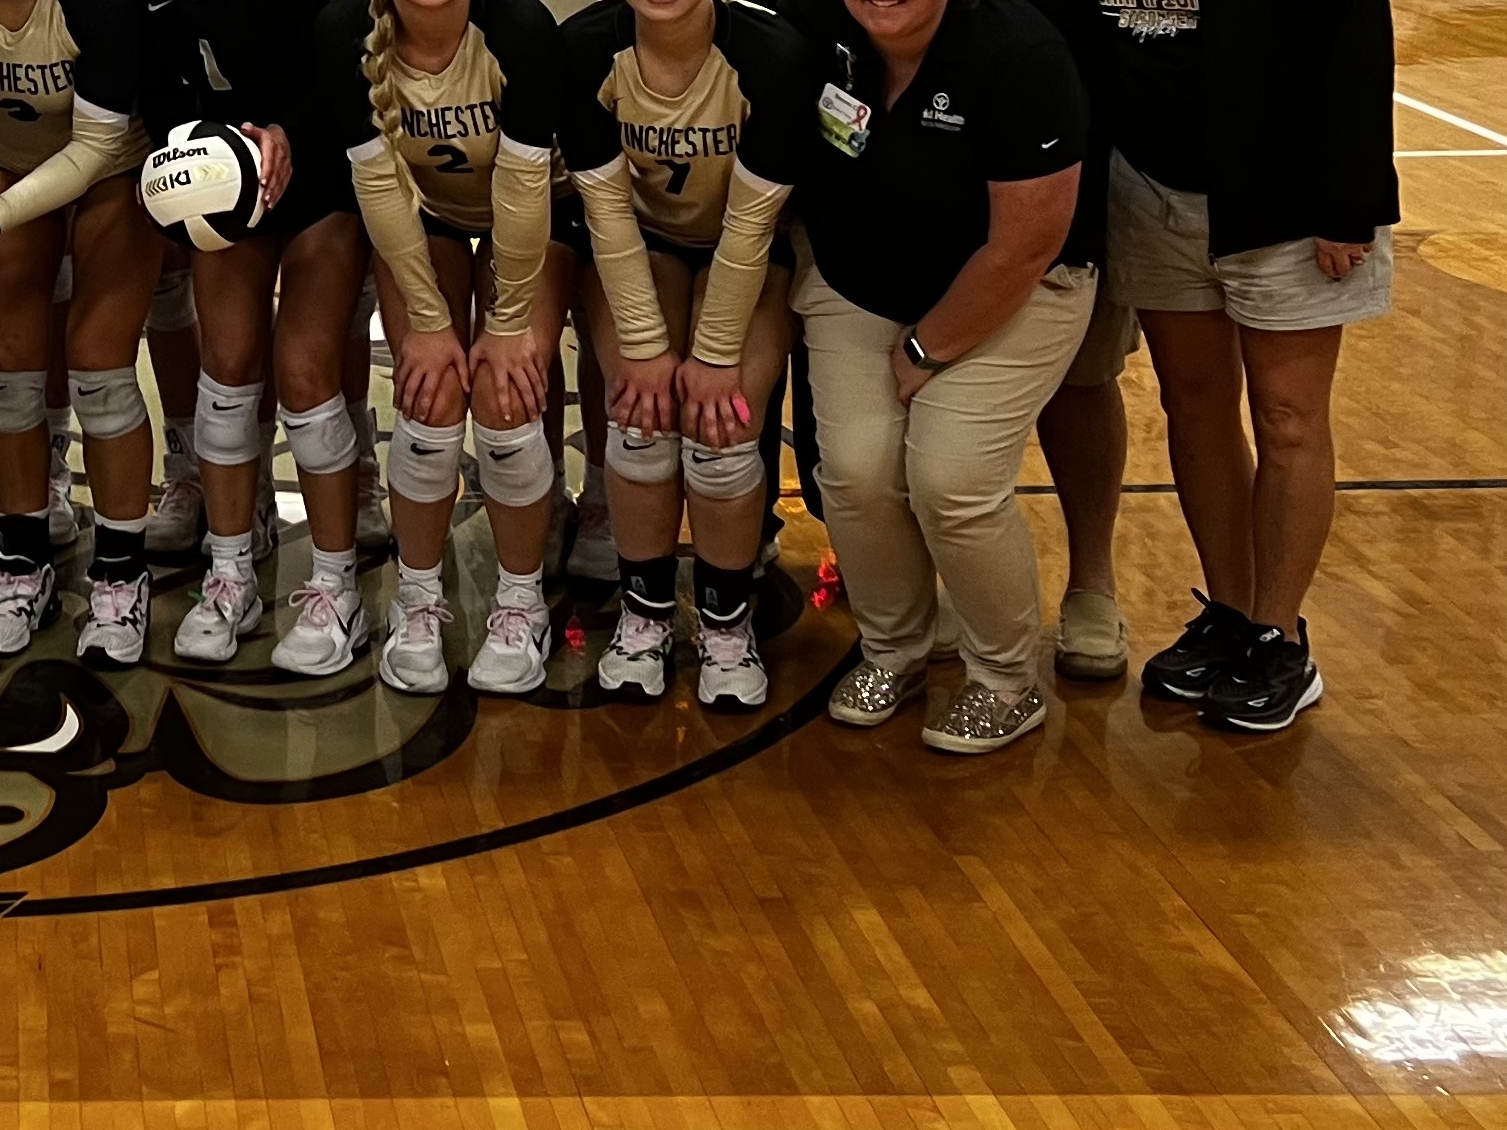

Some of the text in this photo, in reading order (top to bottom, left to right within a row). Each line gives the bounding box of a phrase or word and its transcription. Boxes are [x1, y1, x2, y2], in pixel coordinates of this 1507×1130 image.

[152, 146, 209, 169] Wilson
[427, 144, 475, 174] 2
[655, 159, 691, 196] 7
